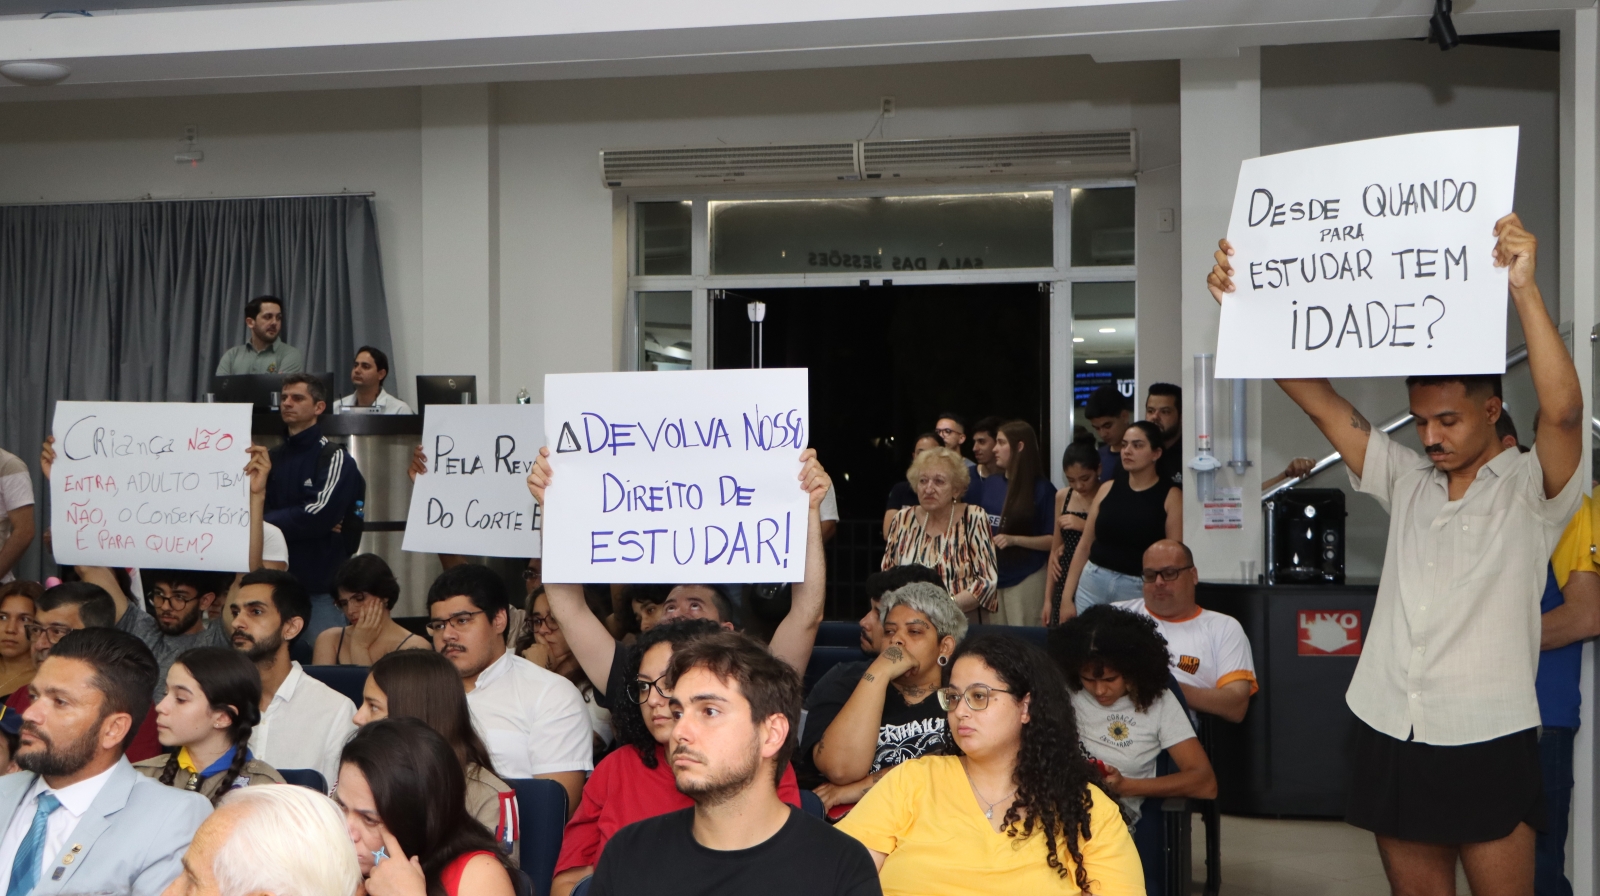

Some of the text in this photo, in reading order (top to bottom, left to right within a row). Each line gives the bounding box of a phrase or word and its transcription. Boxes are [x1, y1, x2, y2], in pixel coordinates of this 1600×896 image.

[1248, 178, 1477, 227] DESDE QUANDO
[1320, 223, 1364, 242] PARA
[1250, 245, 1468, 290] ESTUDAR TEM
[581, 403, 804, 456] DEVOLVA NOSSO
[434, 435, 537, 475] PELA REV
[64, 471, 246, 497] ENTRA, ADULTO TBM
[719, 475, 755, 506] DE
[66, 499, 107, 527] NÃO,
[427, 497, 454, 528] DO
[465, 499, 523, 531] CORTE
[76, 524, 213, 561] É PARA QUEM?
[591, 511, 791, 568] ESTUDAR!
[1107, 714, 1137, 727] CORAÇÃO
